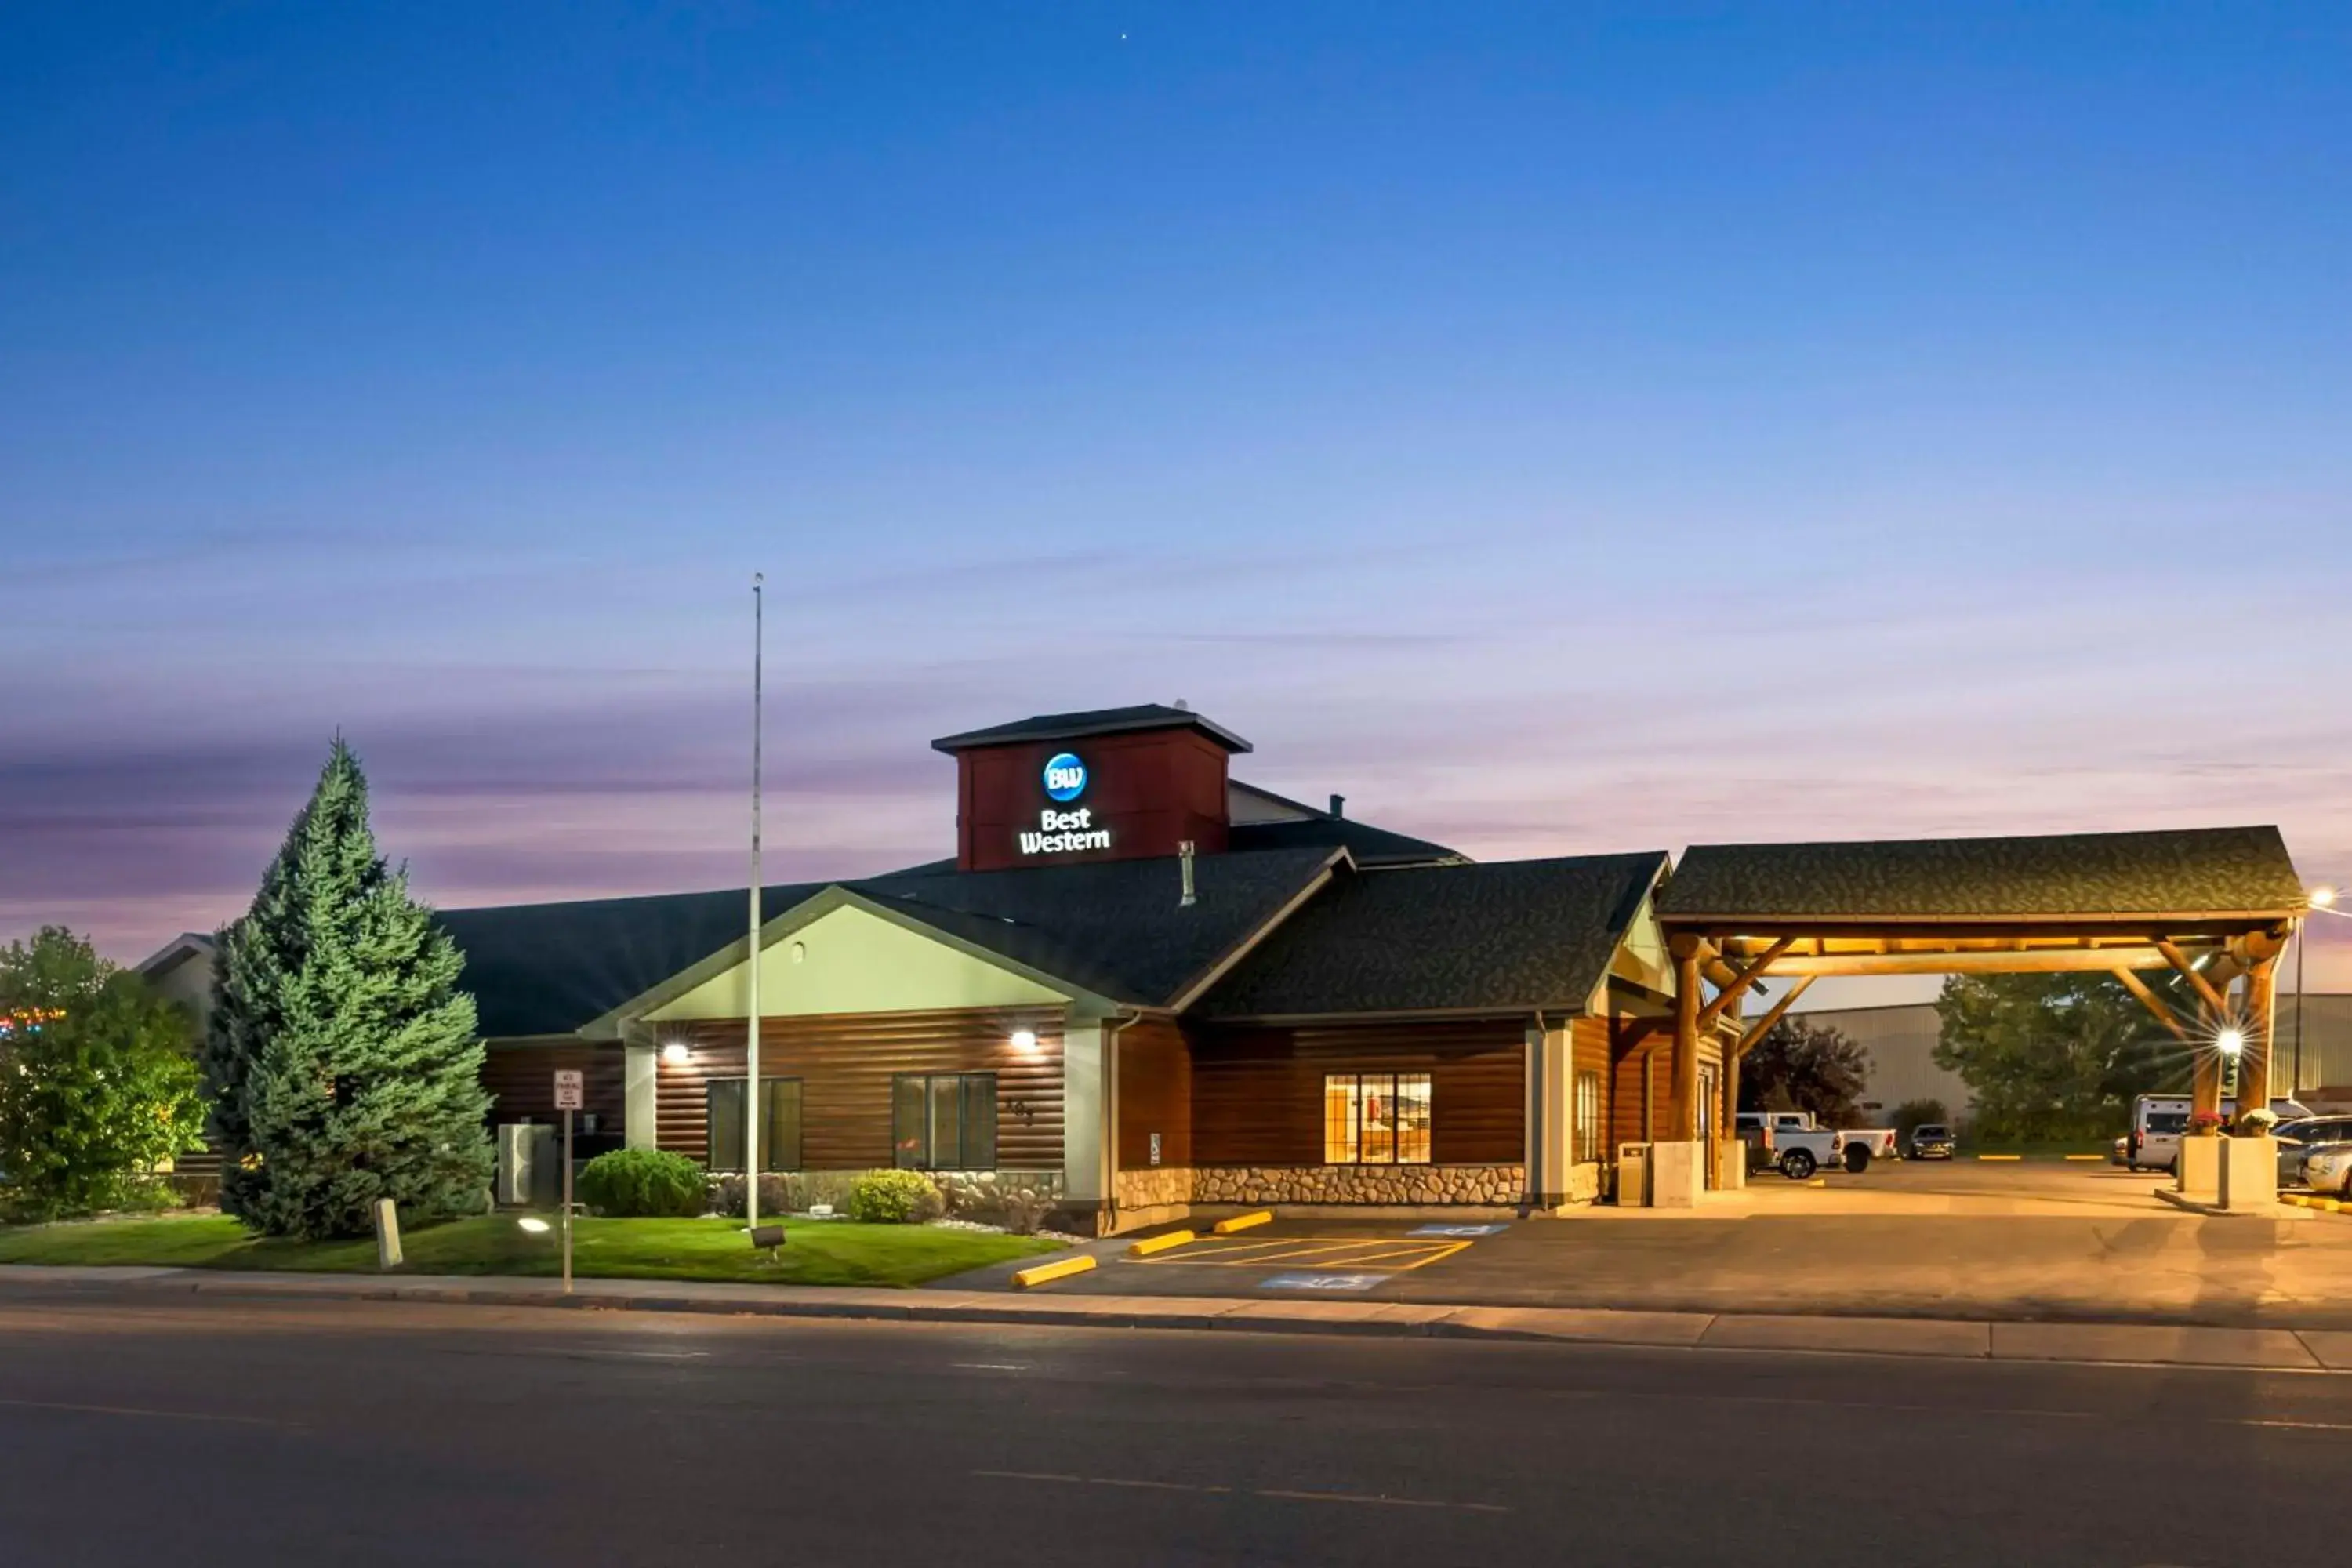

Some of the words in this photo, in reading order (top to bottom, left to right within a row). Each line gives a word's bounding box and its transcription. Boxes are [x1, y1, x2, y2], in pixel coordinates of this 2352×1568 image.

[1048, 766, 1083, 789] BW
[1041, 808, 1091, 832] Best
[1019, 829, 1110, 855] Western
